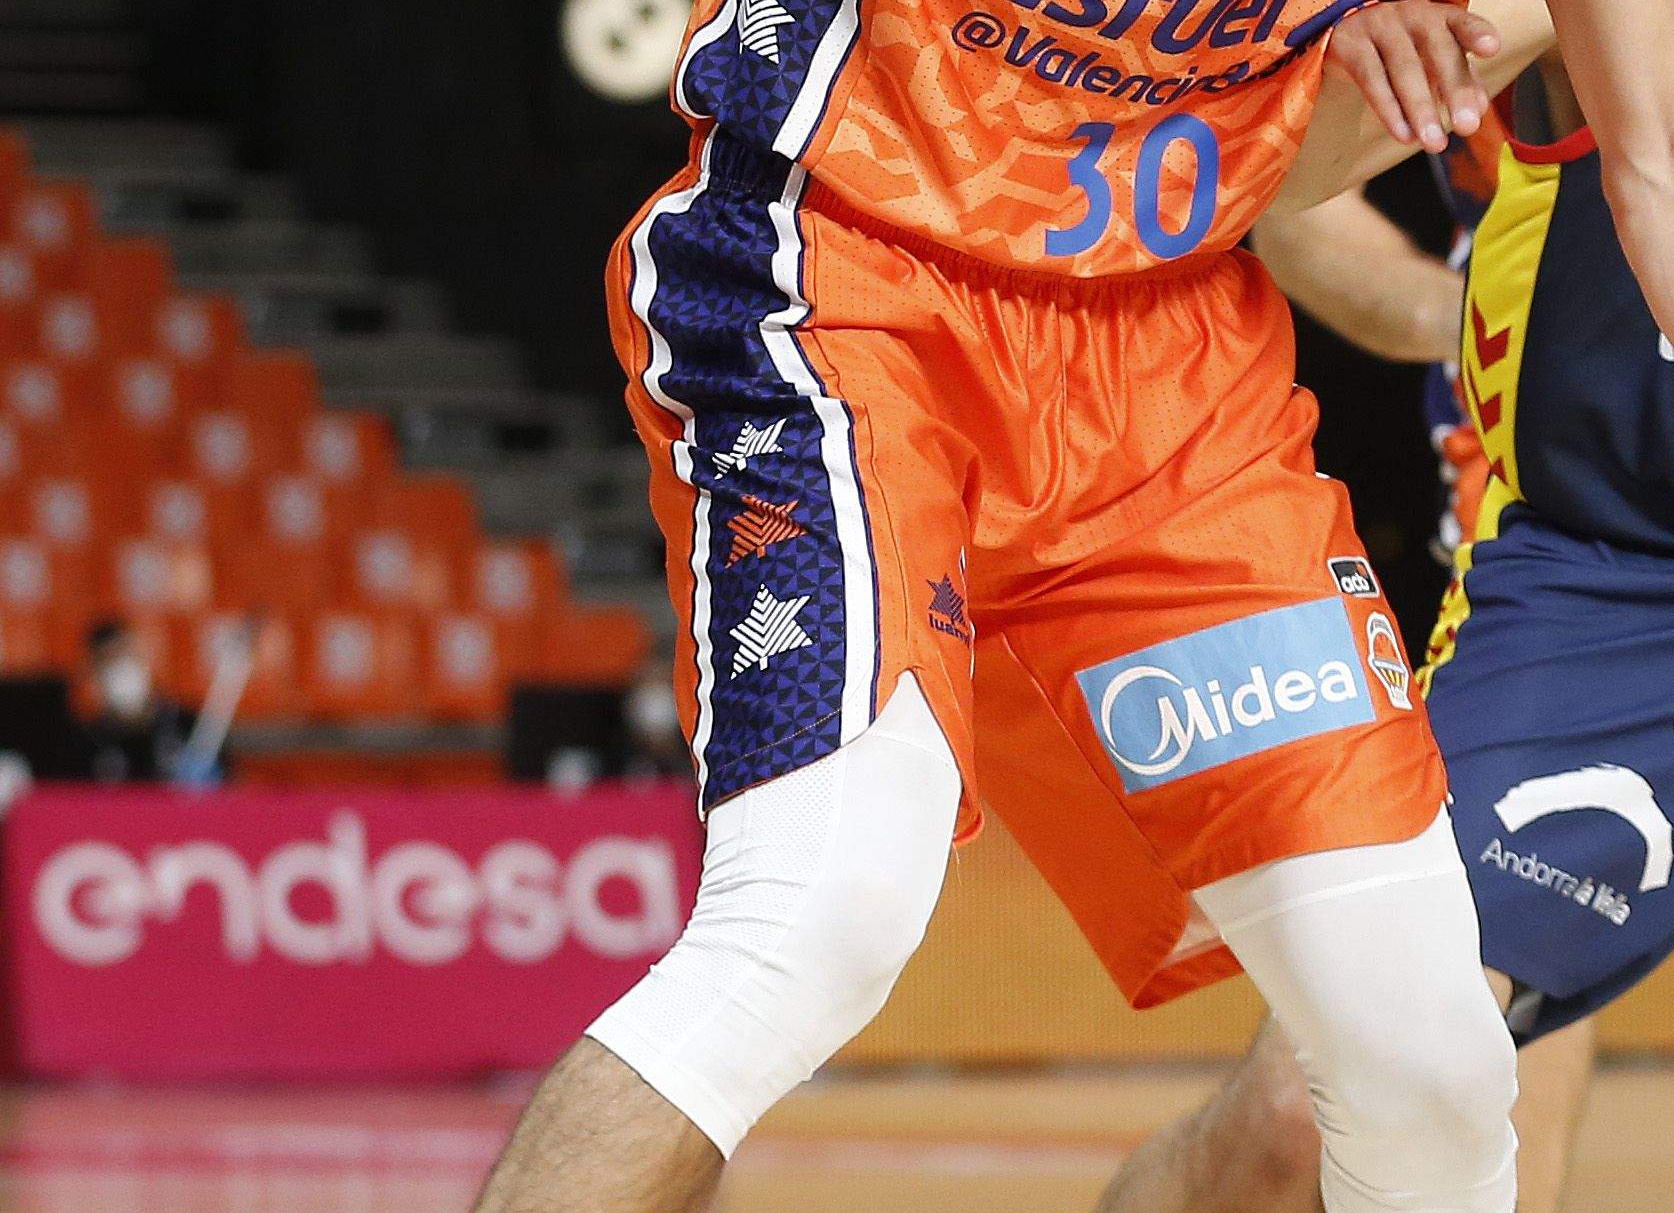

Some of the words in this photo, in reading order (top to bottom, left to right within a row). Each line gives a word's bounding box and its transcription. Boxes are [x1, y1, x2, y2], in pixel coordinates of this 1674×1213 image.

[1043, 113, 1220, 261] 30
[1145, 660, 1358, 764] Midea
[30, 806, 683, 968] endesa
